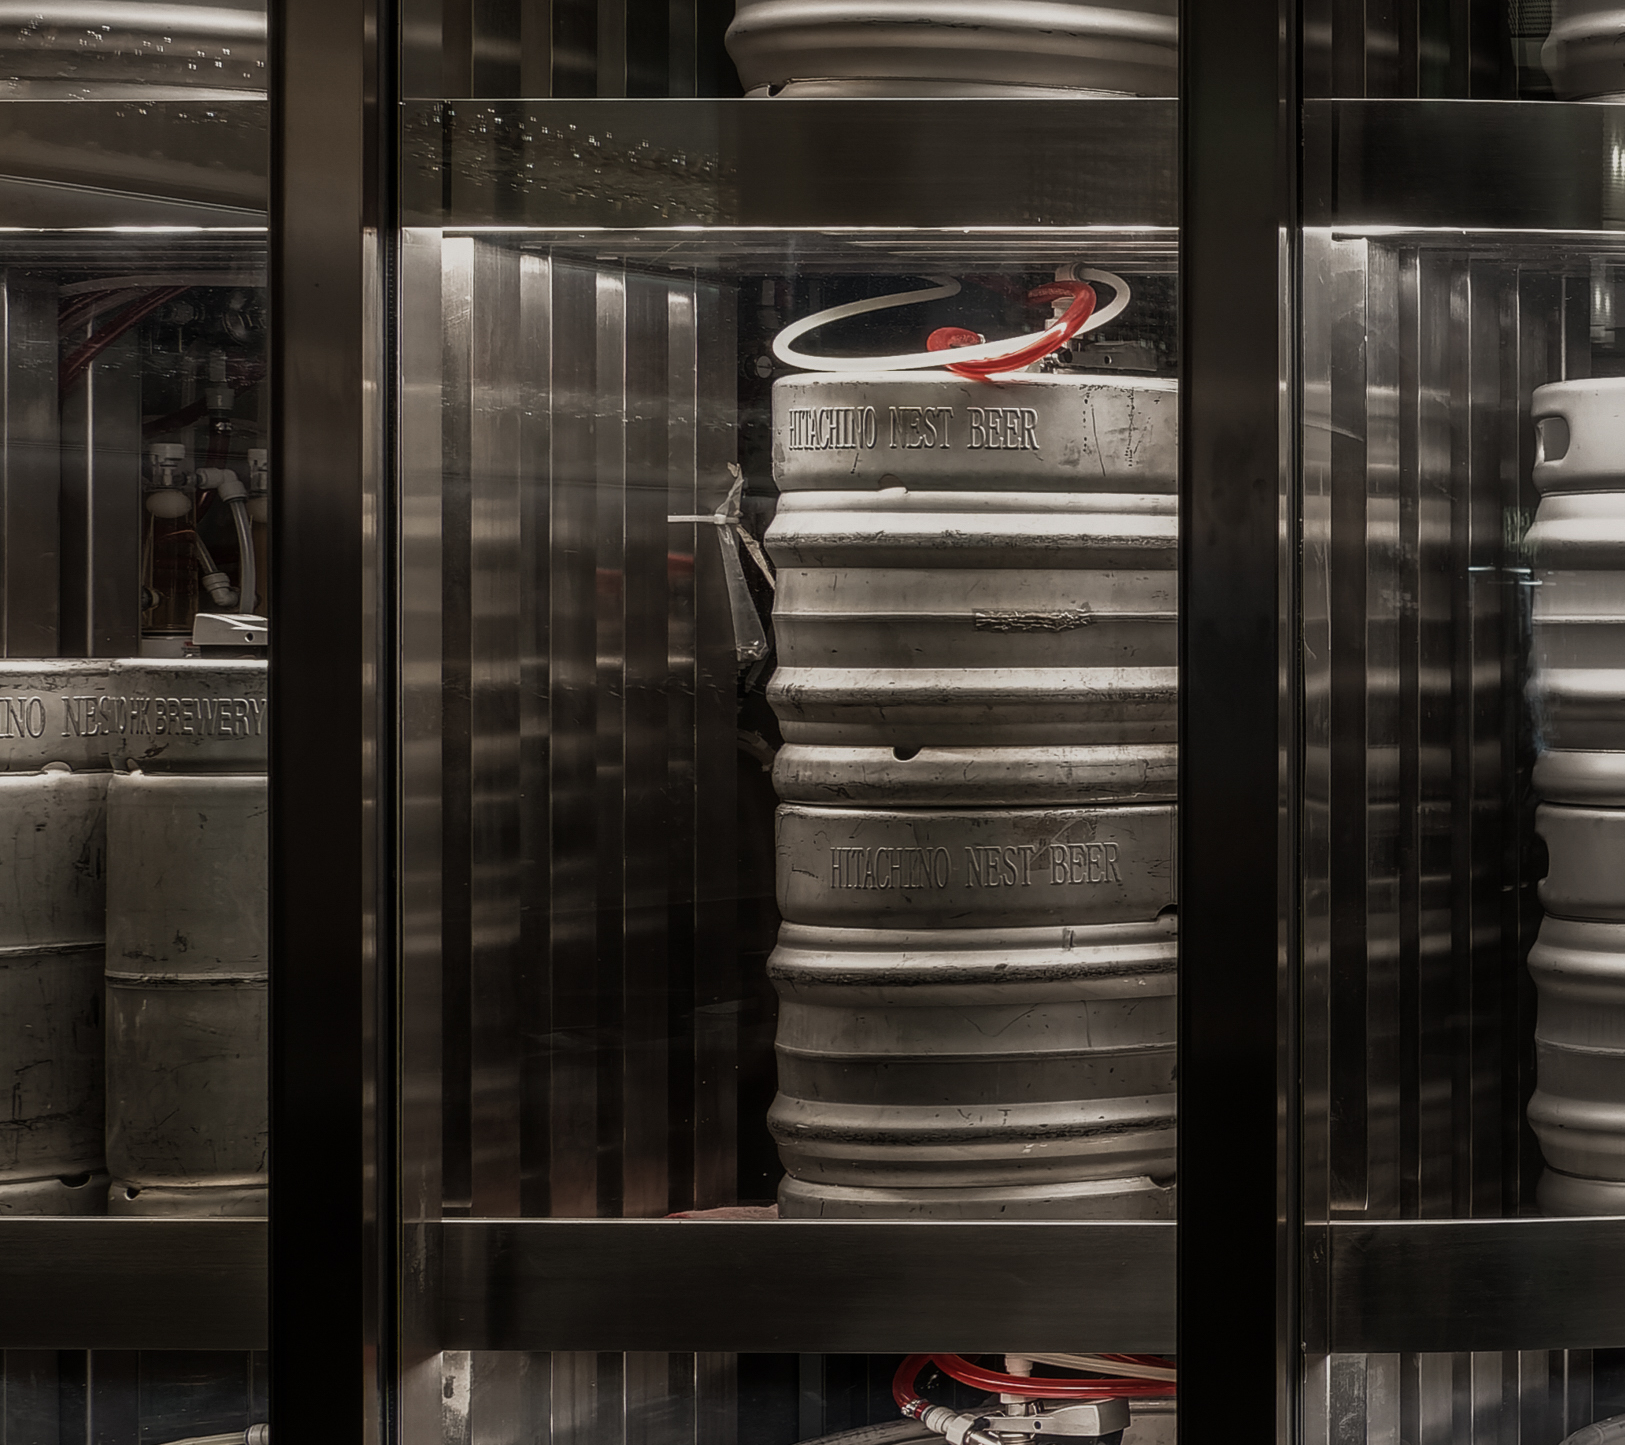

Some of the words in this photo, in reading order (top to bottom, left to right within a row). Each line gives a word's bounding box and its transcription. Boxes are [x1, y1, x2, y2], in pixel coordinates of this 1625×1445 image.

[789, 406, 877, 450] HITACHINO
[888, 406, 953, 450] NEST
[966, 406, 1040, 450] BEER
[155, 697, 267, 736] BREWERY
[830, 846, 950, 890] HITACHINO
[964, 844, 1036, 888] NEST
[1049, 842, 1122, 886] BEER
